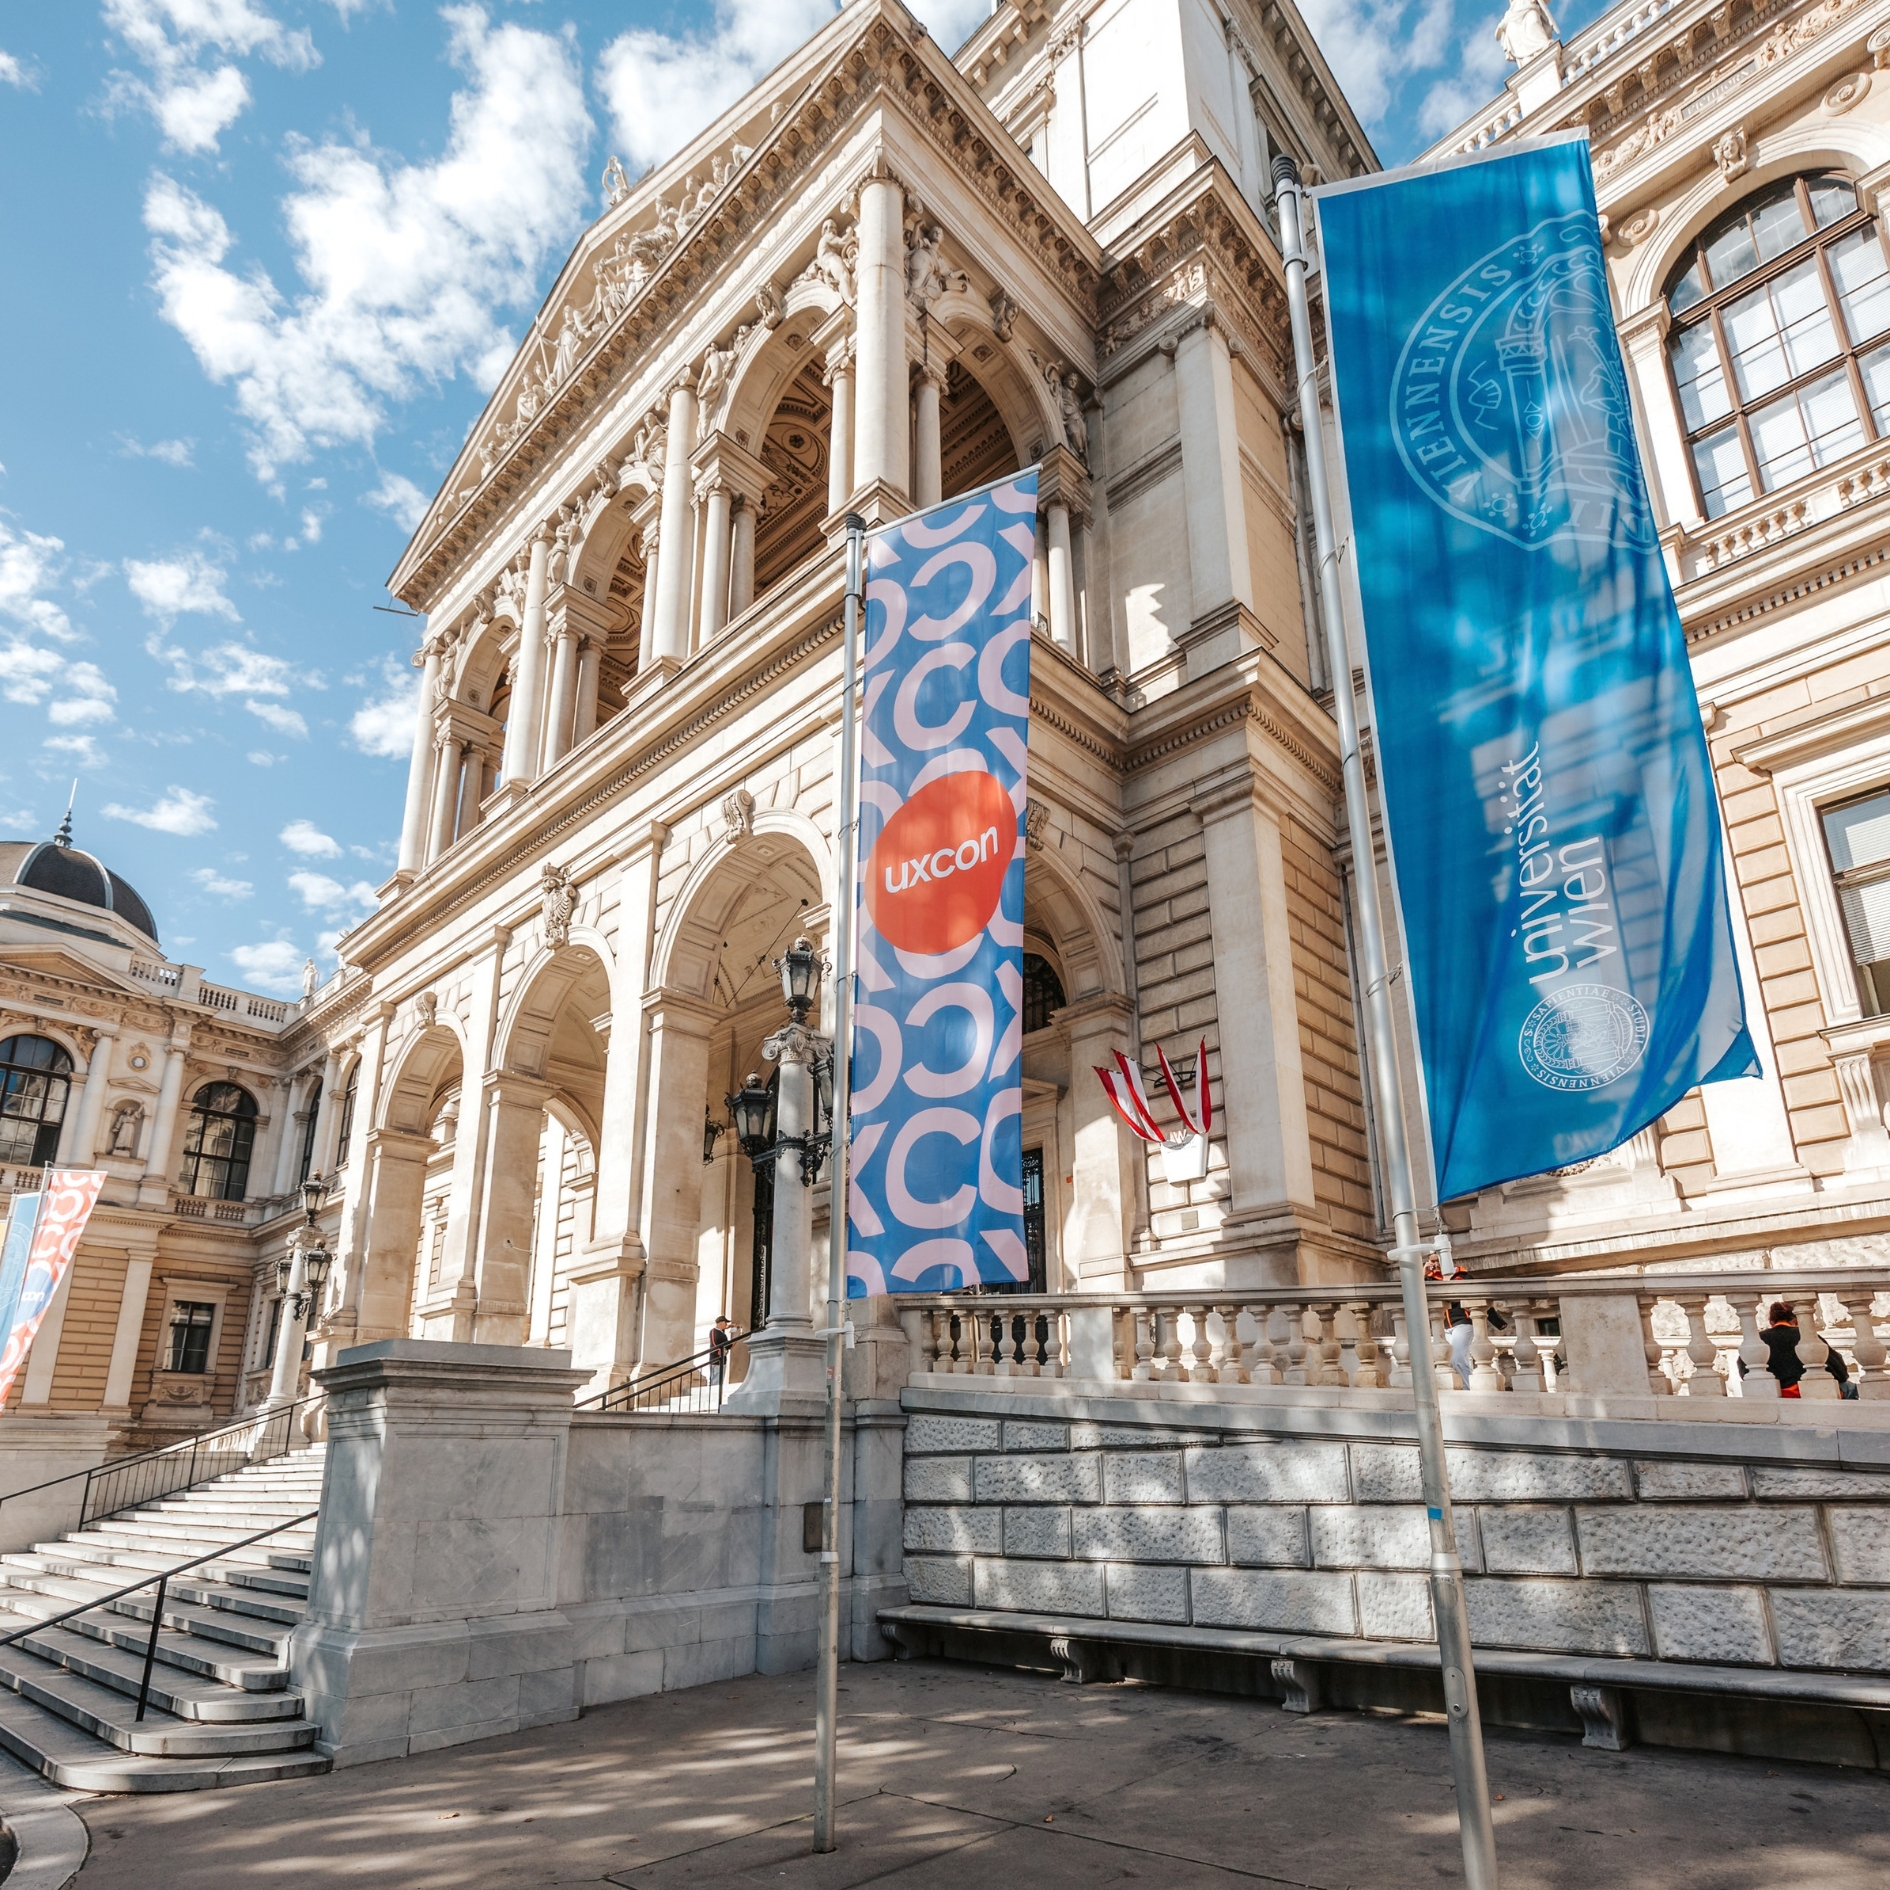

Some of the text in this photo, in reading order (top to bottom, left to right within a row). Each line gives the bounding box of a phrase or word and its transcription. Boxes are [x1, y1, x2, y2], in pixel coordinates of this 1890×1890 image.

[1405, 263, 1512, 503] VIENNENSIS
[885, 826, 998, 894] uxcon
[1498, 740, 1570, 984] universität
[1558, 836, 1617, 969] wien
[1532, 986, 1611, 1021] SAPIENTIAE
[1627, 1003, 1647, 1045] STUDII
[1536, 1065, 1626, 1089] VIENNENSIS
